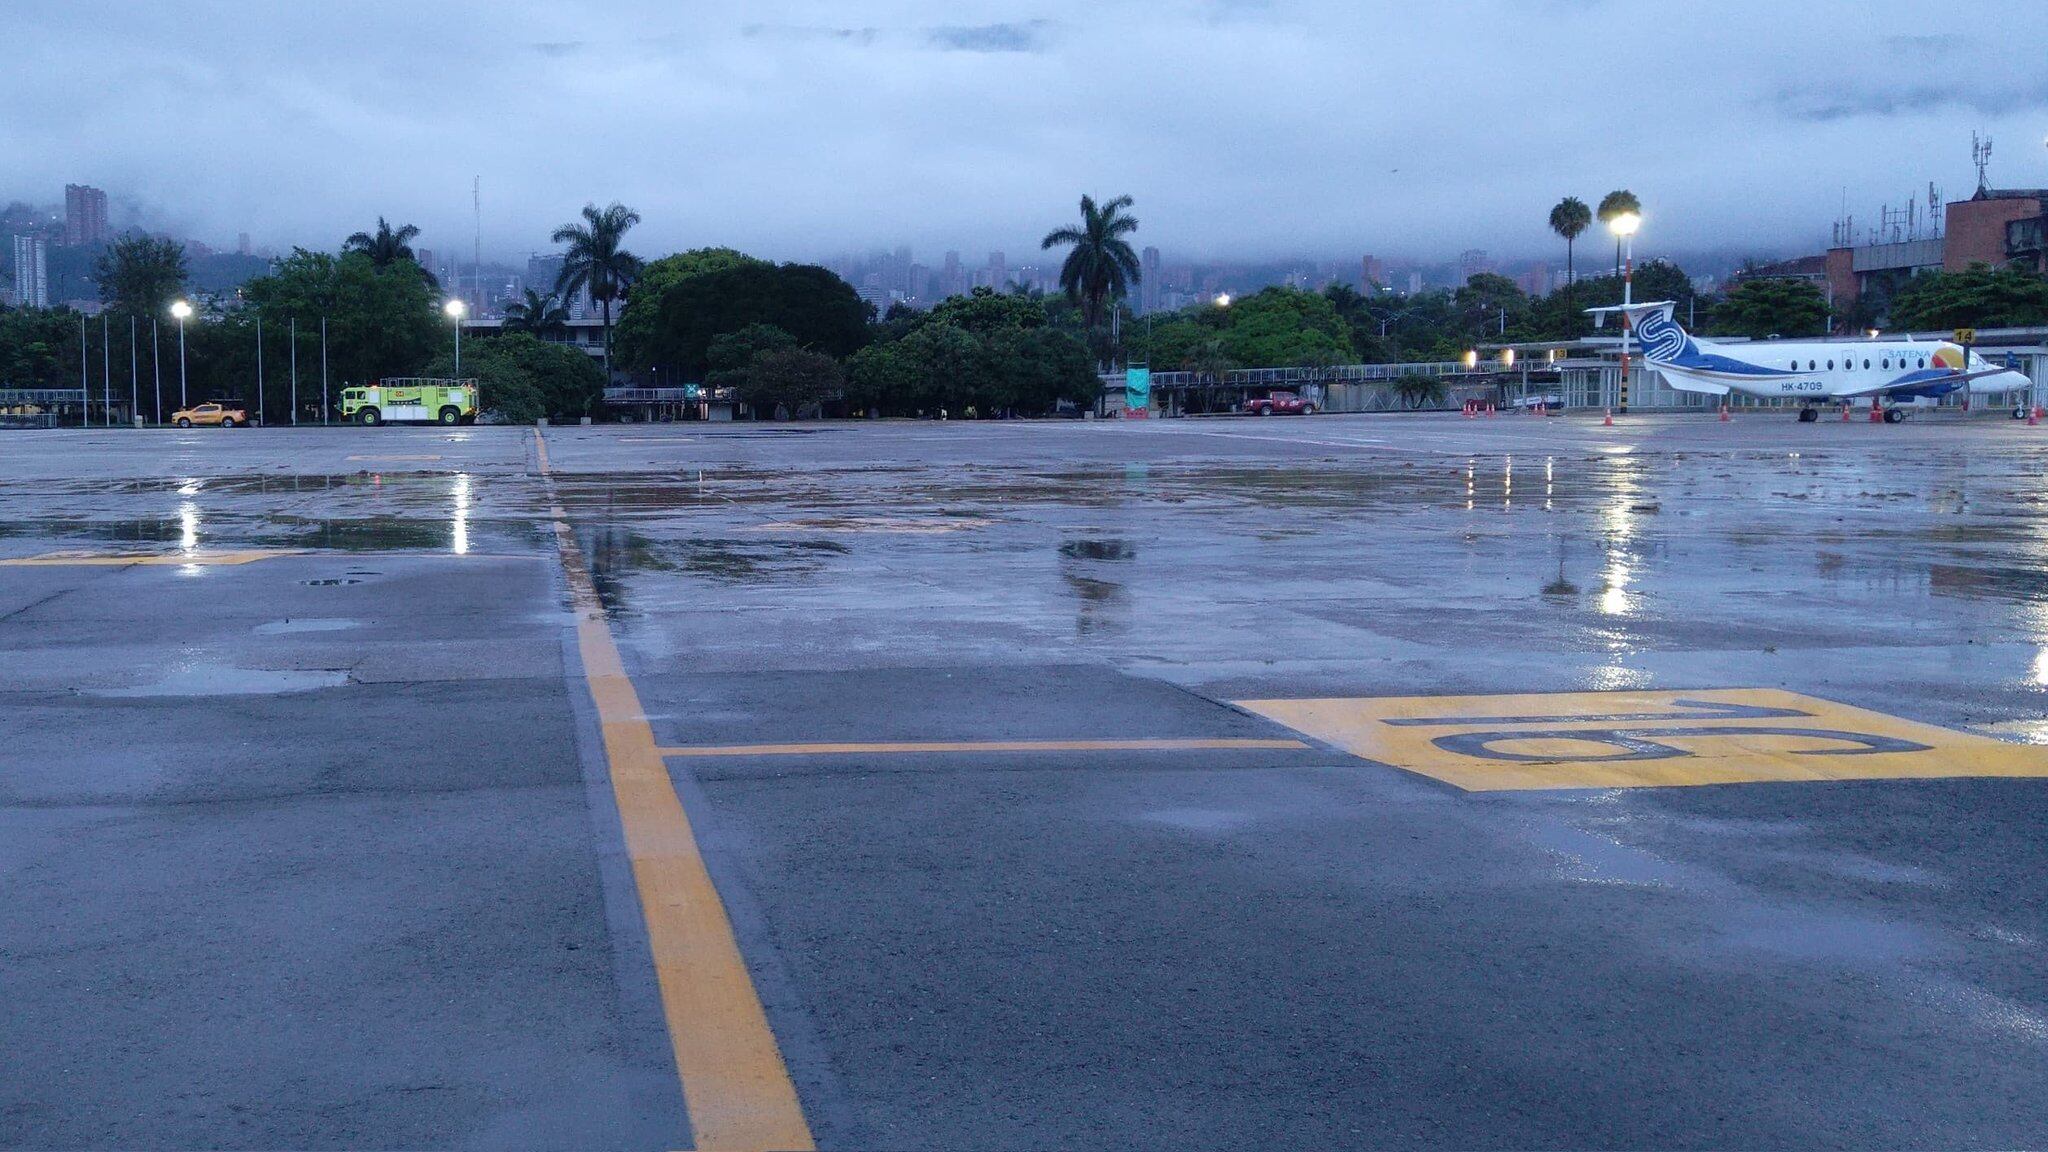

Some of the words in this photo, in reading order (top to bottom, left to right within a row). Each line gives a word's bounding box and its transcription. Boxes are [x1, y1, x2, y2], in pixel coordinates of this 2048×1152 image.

[1956, 331, 1972, 341] 14
[1555, 350, 1565, 358] 13
[1888, 350, 1931, 358] SATENA
[1781, 381, 1823, 391] HK-4709
